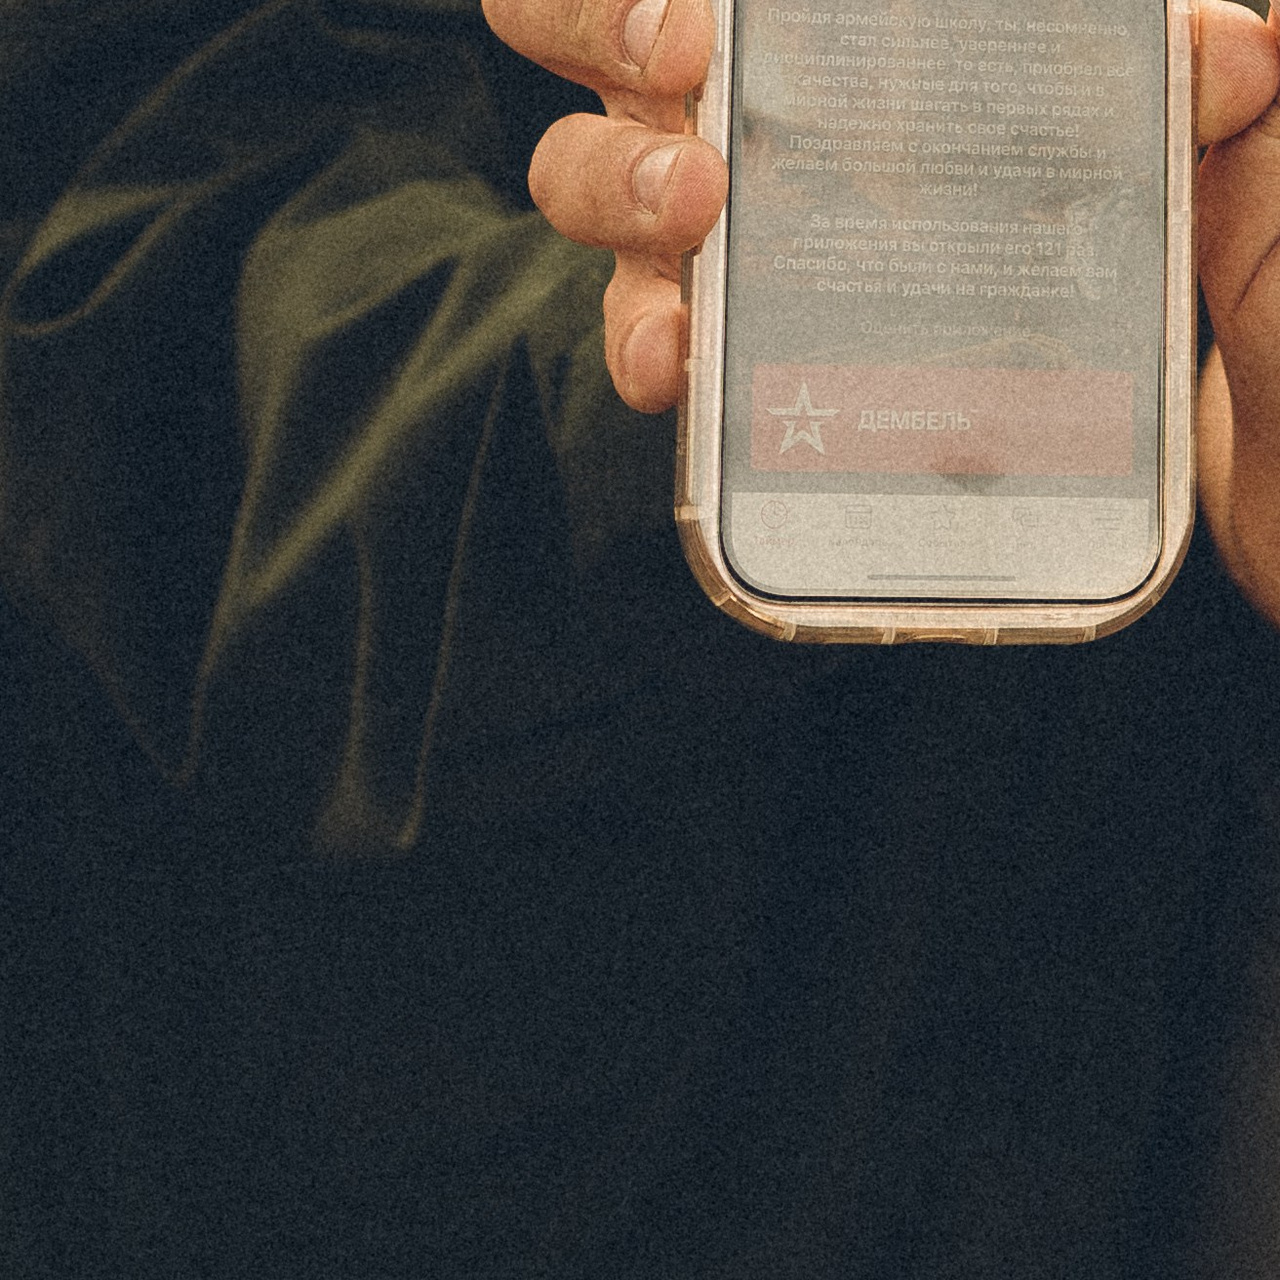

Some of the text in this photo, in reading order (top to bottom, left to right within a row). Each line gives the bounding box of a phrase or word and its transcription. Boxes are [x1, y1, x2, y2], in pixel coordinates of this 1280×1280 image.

[768, 9, 831, 25] Пройдя
[835, 11, 931, 31] армейскую
[840, 34, 877, 48] стал
[978, 60, 1017, 76] есть,
[878, 77, 944, 93] нужные
[948, 79, 977, 94] для
[851, 96, 908, 111] жизни
[911, 98, 969, 113] шагать
[974, 100, 982, 113] в
[987, 102, 1047, 118] первых
[1052, 104, 1100, 119] рядах
[1104, 106, 1114, 118] и
[896, 118, 963, 135] хранить
[1011, 122, 1080, 138] счастье!
[789, 134, 903, 154] Поздравляем
[908, 140, 917, 151] с
[922, 140, 1023, 157] окончанием
[1028, 142, 1091, 161] службы
[772, 155, 1123, 182] желаем большой любви и удачи в мирной
[920, 181, 978, 197] жизни!
[810, 214, 1084, 237] За время использования нашего
[793, 236, 897, 253] приложения
[930, 240, 1001, 256] открыли
[1005, 243, 1032, 258] его
[1036, 241, 1062, 256] 121
[774, 254, 1117, 280] Спасибо, что были с нами, и желаем вам
[816, 278, 1075, 300] счастья и удачи на гражданке!
[858, 410, 971, 432] ДЕМБЕЛЬ
